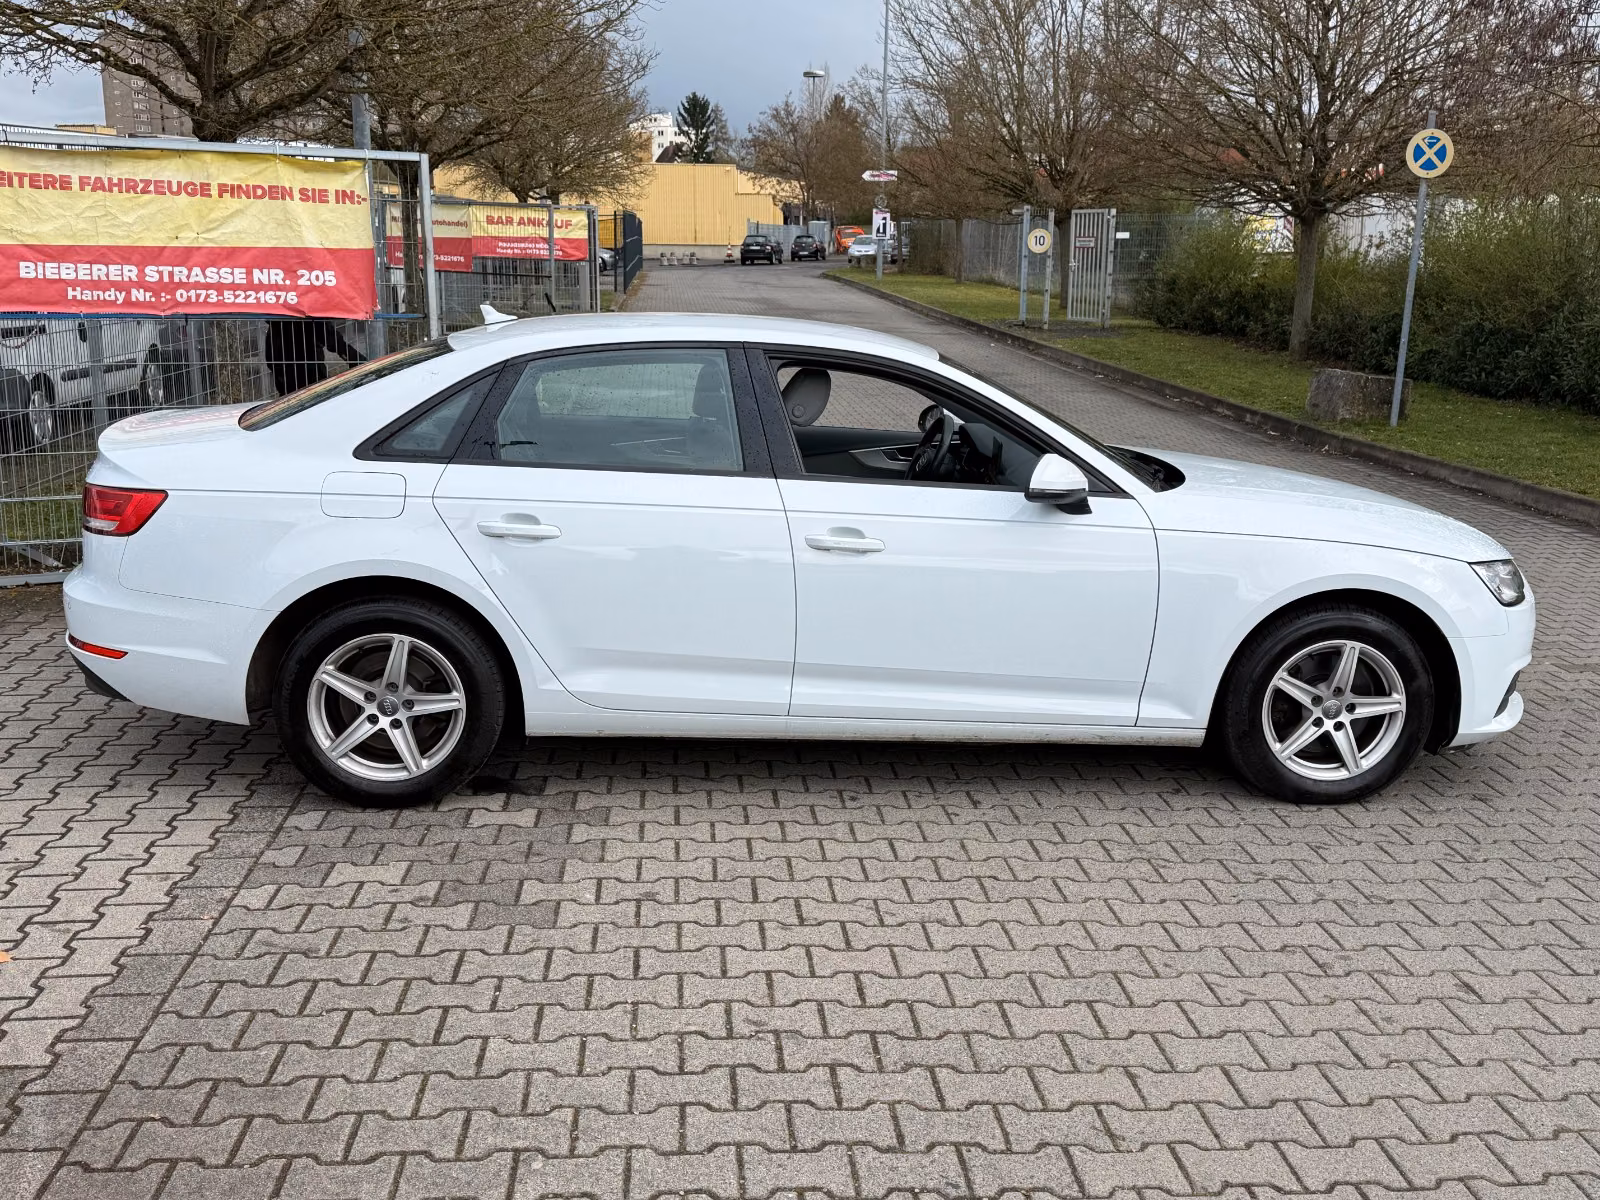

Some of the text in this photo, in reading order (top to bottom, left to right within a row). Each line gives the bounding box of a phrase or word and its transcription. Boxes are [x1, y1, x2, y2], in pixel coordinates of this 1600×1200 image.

[79, 175, 212, 198] FAHRZEUGE
[217, 183, 294, 201] FINDEN
[299, 187, 329, 204] SIE
[335, 189, 367, 205] IN:-
[486, 215, 514, 226] BAR
[1034, 235, 1046, 246] 10
[19, 261, 337, 286] BIEBERER STRASSE NR. 205
[67, 287, 126, 304] Handy
[131, 288, 156, 302] Nr.
[175, 289, 298, 304] 0173-5221676
